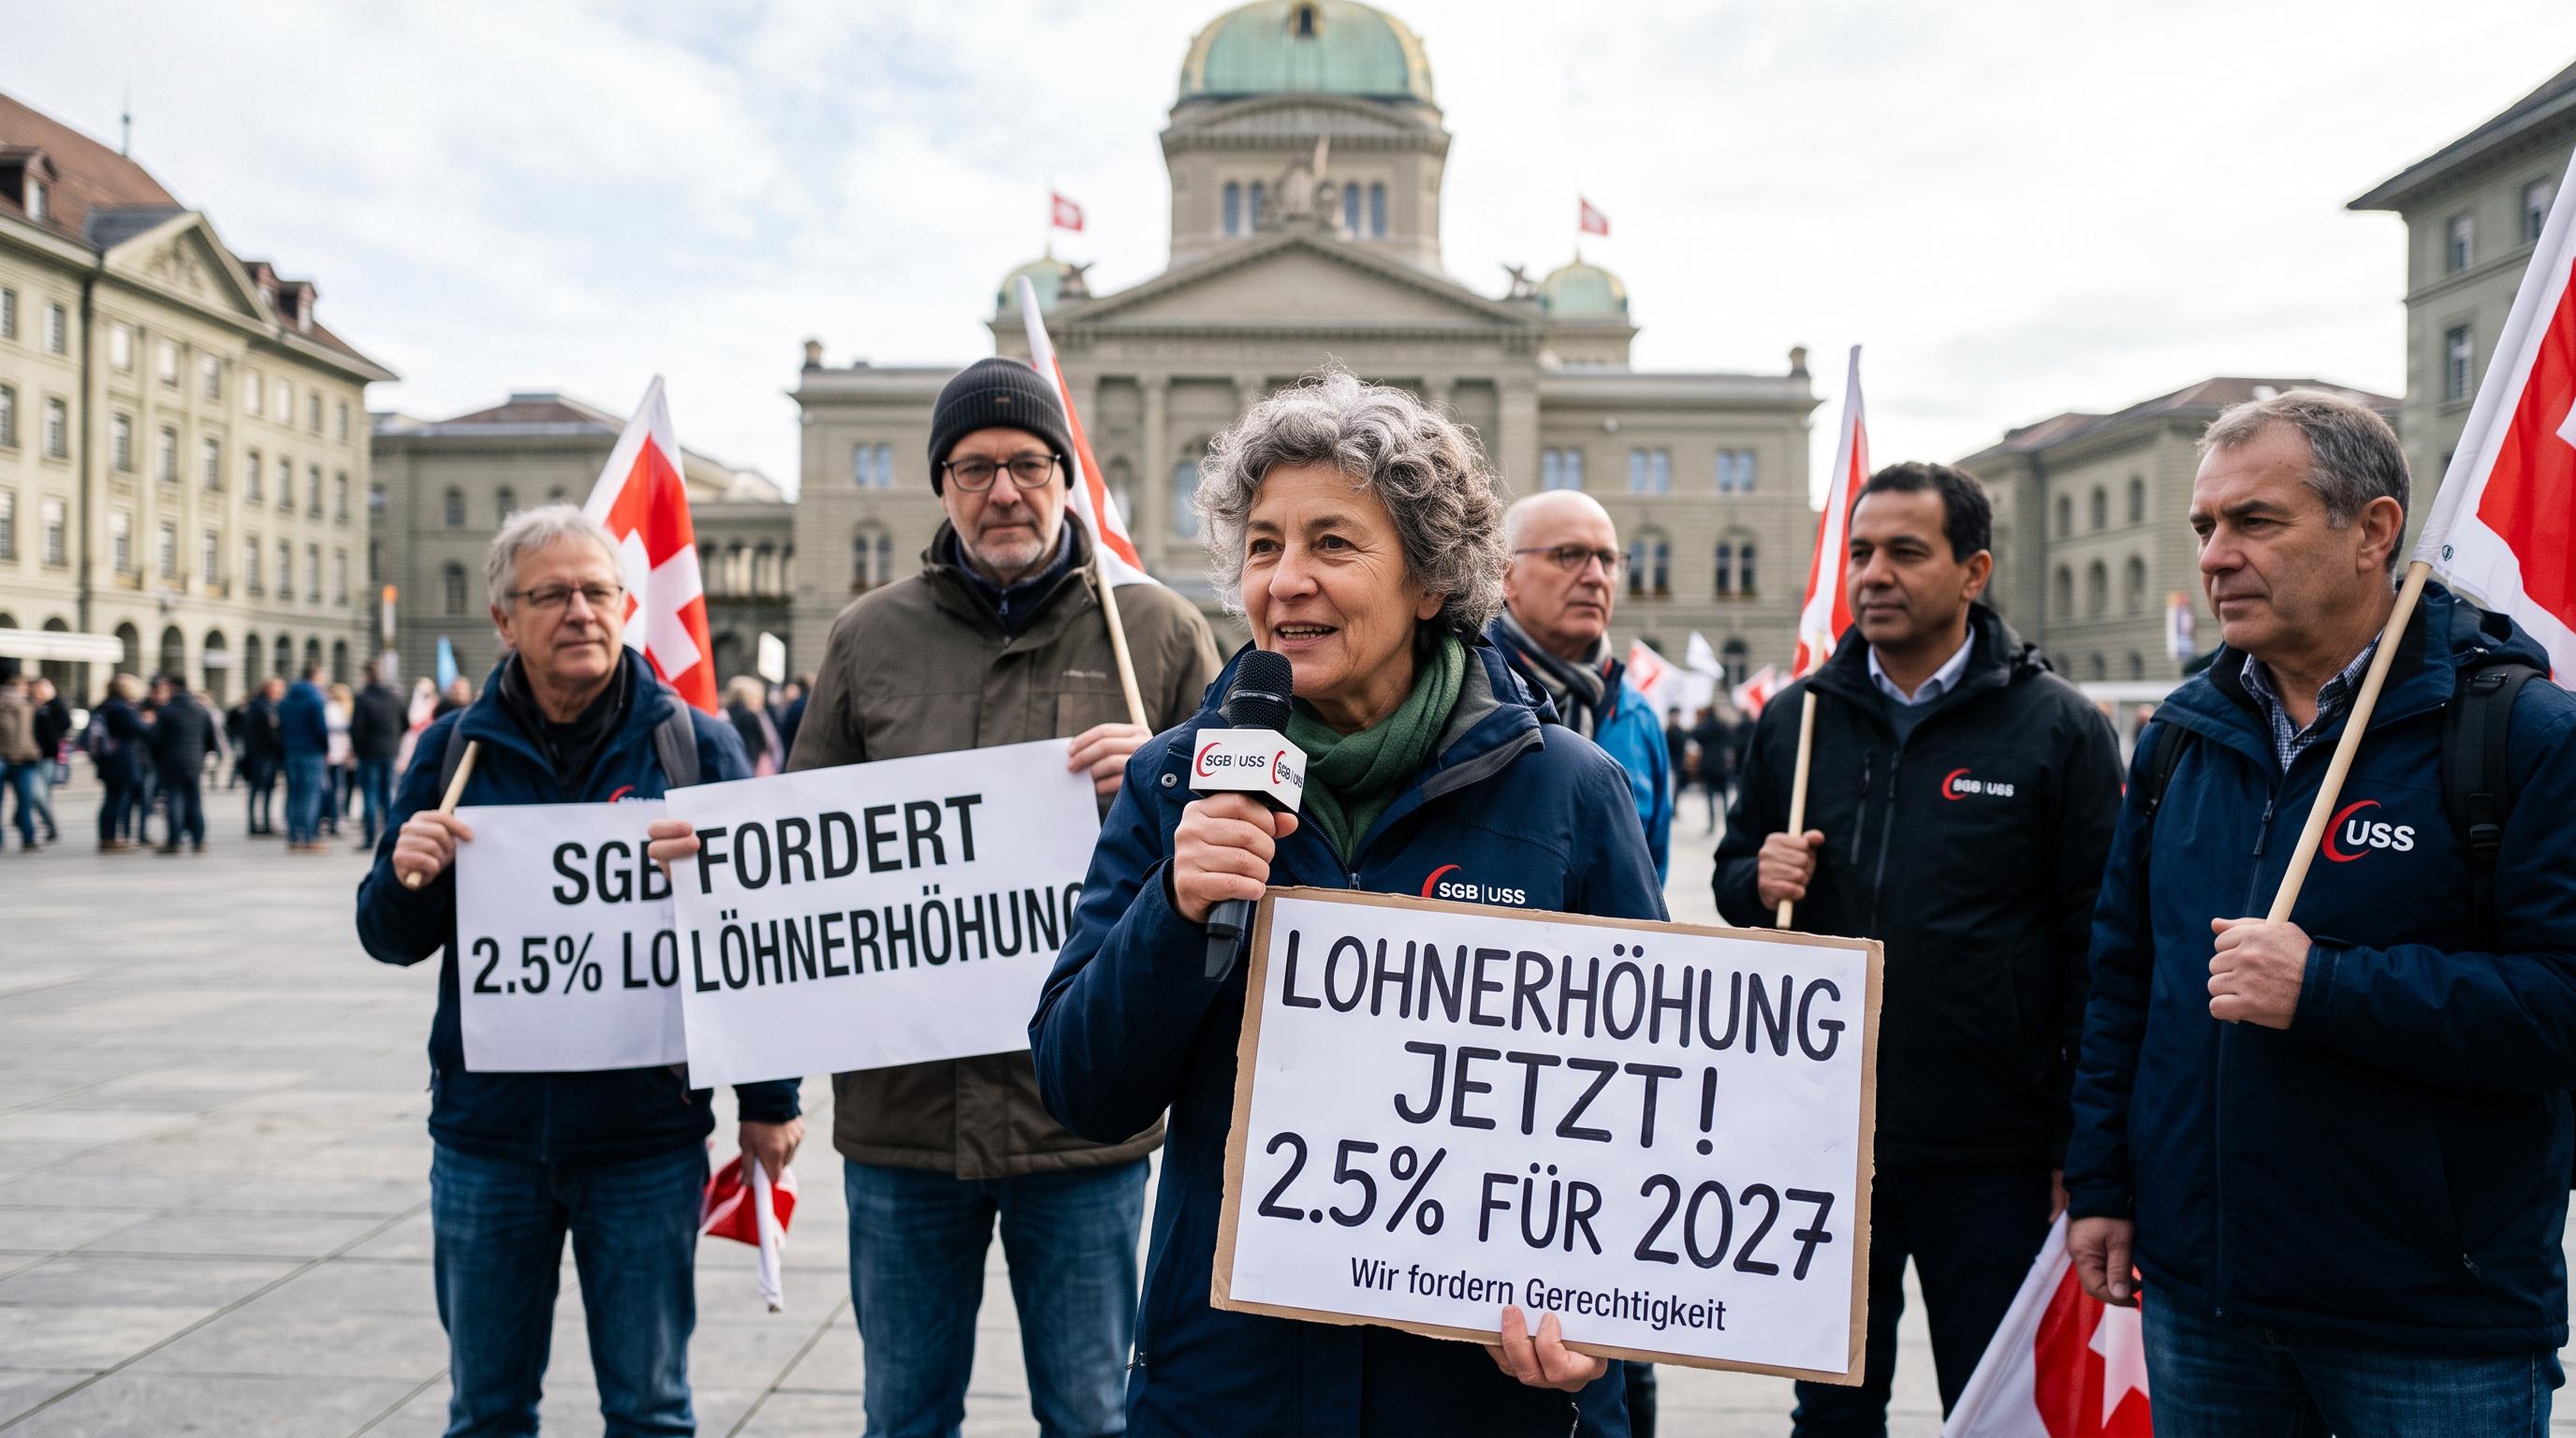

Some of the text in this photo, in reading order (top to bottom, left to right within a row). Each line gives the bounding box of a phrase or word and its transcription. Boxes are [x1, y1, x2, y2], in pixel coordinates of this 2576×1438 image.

[1205, 754, 1266, 768] SGB USS
[1986, 782, 2014, 798] USS
[695, 793, 983, 895] FORDERT
[2346, 819, 2415, 852] USS
[1439, 882, 1526, 905] SGB USS
[472, 932, 603, 996] 2.5%
[1282, 930, 1846, 1062] LOHNERHÖHUNG
[1257, 1131, 1836, 1282] 2.5% FÜR 2027
[1351, 1256, 1727, 1331] Wir fordern Gerechtigkeit
